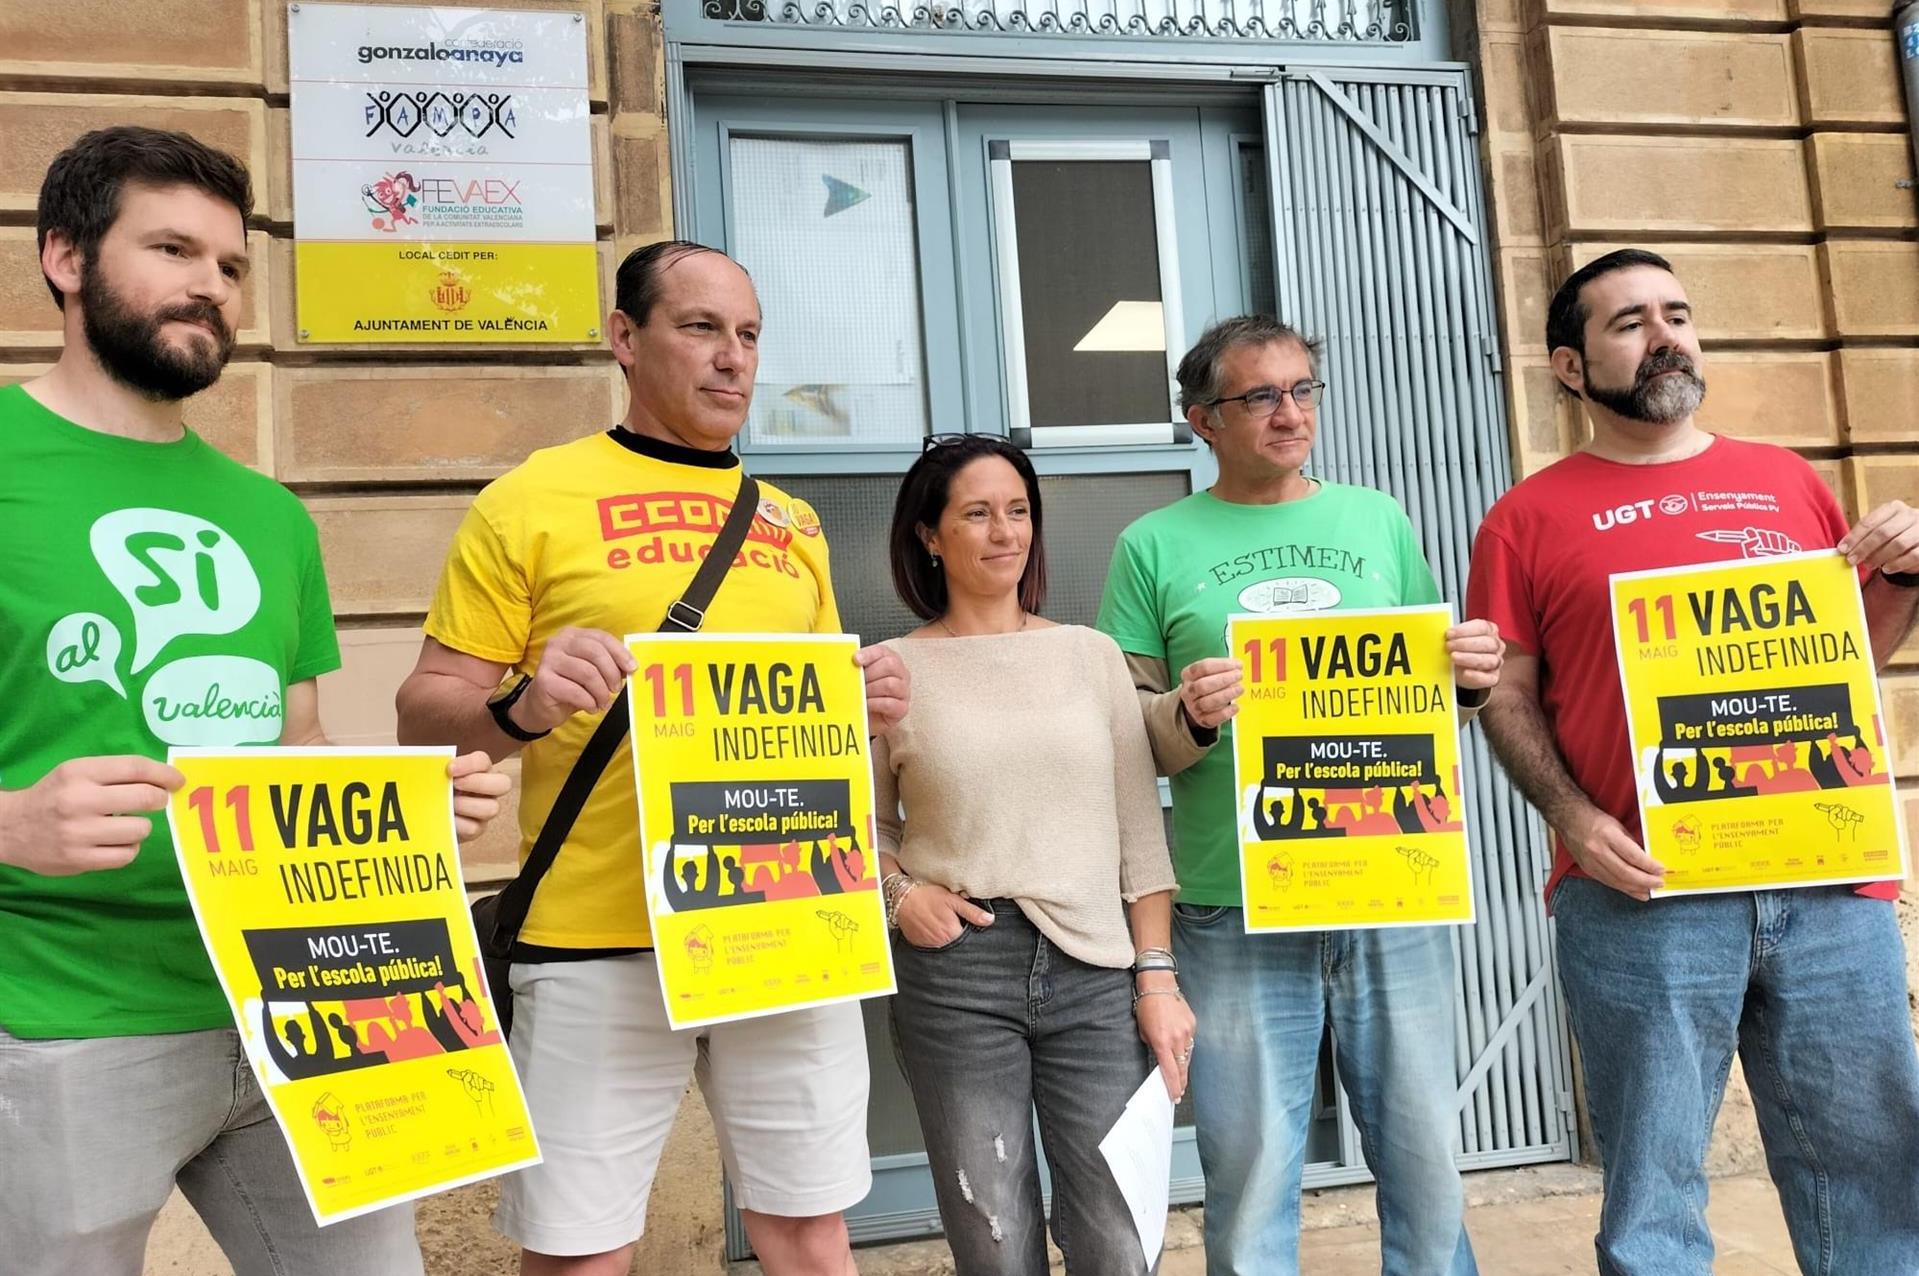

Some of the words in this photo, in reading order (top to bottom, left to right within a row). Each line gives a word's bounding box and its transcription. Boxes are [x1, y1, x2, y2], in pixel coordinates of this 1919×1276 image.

[445, 38, 523, 49] coederació
[421, 178, 522, 205] FEVAEX
[472, 206, 523, 214] EDUCATIVA
[483, 213, 523, 221] VALENCIANA
[398, 250, 436, 260] LOCAL
[438, 250, 470, 260] CEDIT
[472, 251, 499, 260] PER:
[353, 319, 451, 331] AJUNTAMENT
[454, 319, 474, 331] DE
[1592, 499, 1655, 531] UGT
[1697, 491, 1777, 503] Ensenyament
[1208, 544, 1367, 586] ESTIMEM
[1628, 594, 1677, 643] 11
[1688, 580, 1816, 636] VAGA
[56, 621, 100, 672] al
[1244, 637, 1287, 683] 11
[1300, 632, 1412, 680] VAGA
[1639, 645, 1678, 661] MAIG
[1696, 631, 1859, 676] INDEFINIDA
[644, 663, 695, 718] 11
[708, 662, 825, 715] VAGA
[1250, 686, 1286, 701] MAIG
[1302, 684, 1445, 719] INDEFINIDA
[1711, 694, 1797, 717] MOU-TE.
[1675, 722, 1704, 740] Per
[1774, 712, 1839, 735] pública!
[654, 722, 695, 738] MAIG
[713, 723, 860, 762] INDEFINIDA
[1310, 741, 1387, 760] MOU-TE.
[1276, 762, 1301, 780] Per
[1364, 760, 1422, 780] pública!
[724, 788, 804, 809] MOU-TE.
[188, 785, 256, 853] 11
[269, 781, 409, 849] VAGA
[688, 813, 715, 834] Per
[781, 809, 838, 833] pública!
[209, 858, 258, 877] MAIG
[279, 853, 453, 904] INDEFINIDA
[307, 931, 399, 960] MOU-TE.
[274, 966, 305, 990] Per
[380, 956, 443, 984] pública!
